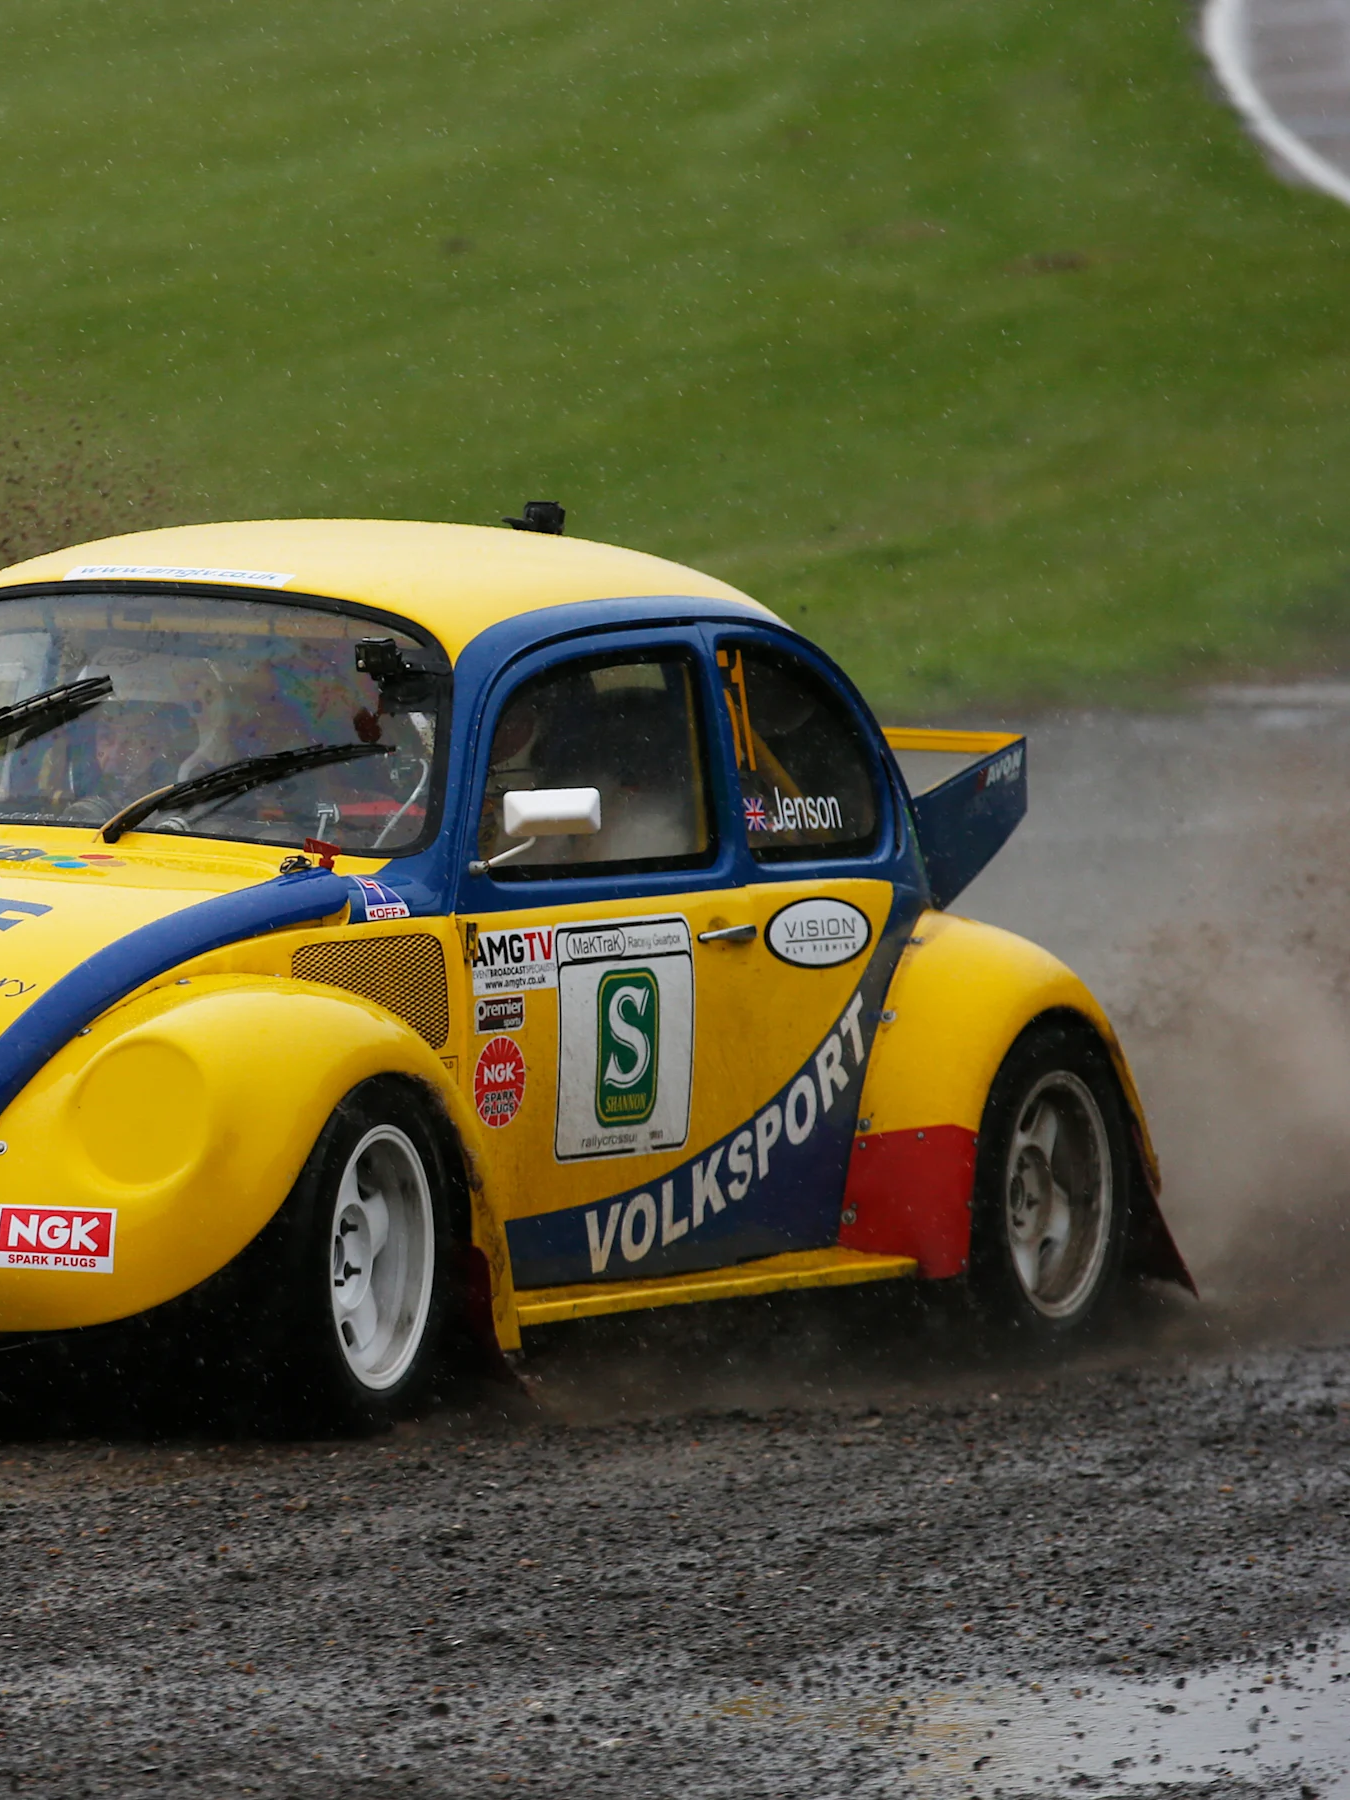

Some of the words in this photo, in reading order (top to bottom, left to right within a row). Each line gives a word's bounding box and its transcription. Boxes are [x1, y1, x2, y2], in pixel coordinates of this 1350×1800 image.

[772, 786, 843, 833] Jenson
[784, 917, 856, 938] VISION
[472, 931, 553, 968] AMGTV
[813, 941, 856, 953] FISHING
[485, 974, 547, 990] www.amgtv.co.uk
[477, 998, 523, 1021] Premier
[483, 1061, 517, 1086] NGK
[483, 1090, 515, 1104] SPARK
[605, 1092, 647, 1113] SHANNON
[483, 1102, 515, 1116] PLUGS
[584, 991, 865, 1275] VOLKSPORT
[7, 1213, 101, 1253] NGK
[8, 1253, 49, 1265] SPARK
[54, 1256, 97, 1268] PLUGS
